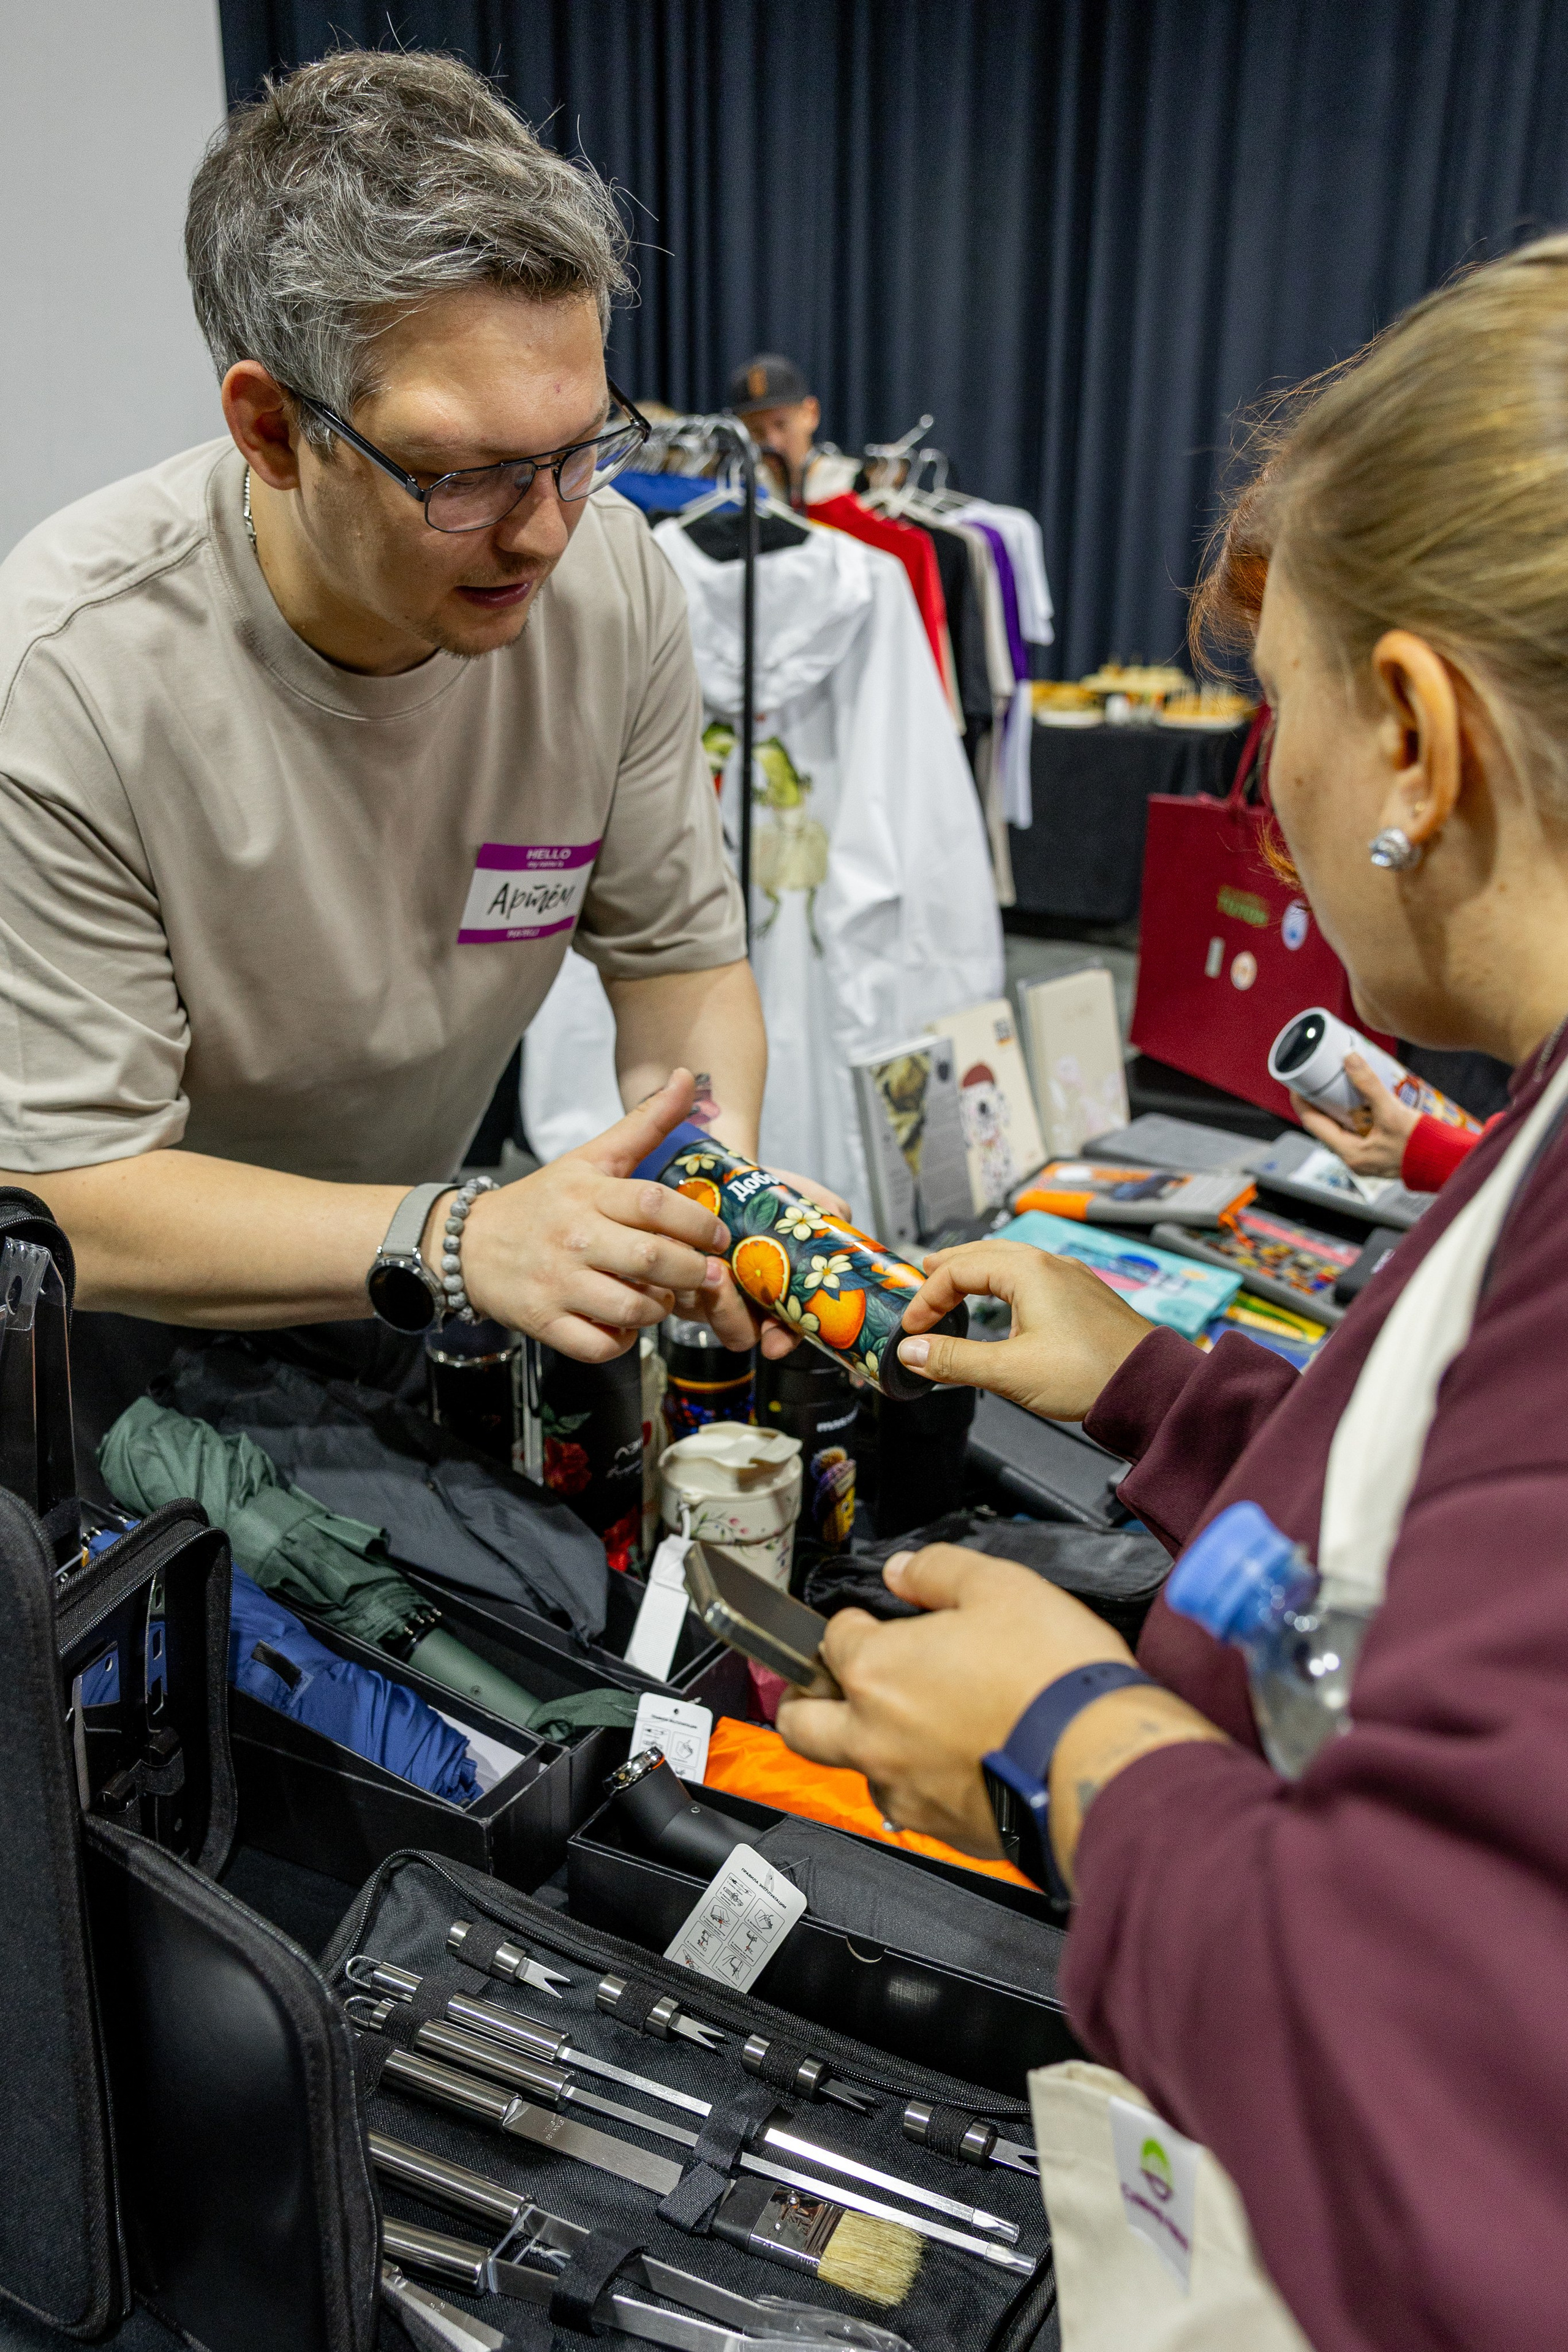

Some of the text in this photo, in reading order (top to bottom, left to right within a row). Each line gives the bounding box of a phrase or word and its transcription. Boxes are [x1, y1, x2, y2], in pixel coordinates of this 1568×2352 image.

[526, 848, 571, 860] HELLO
[741, 1868, 759, 1885] ПРАВИЛА
[758, 1883, 787, 1909] ЭКСПЛУАТАЦИИ
